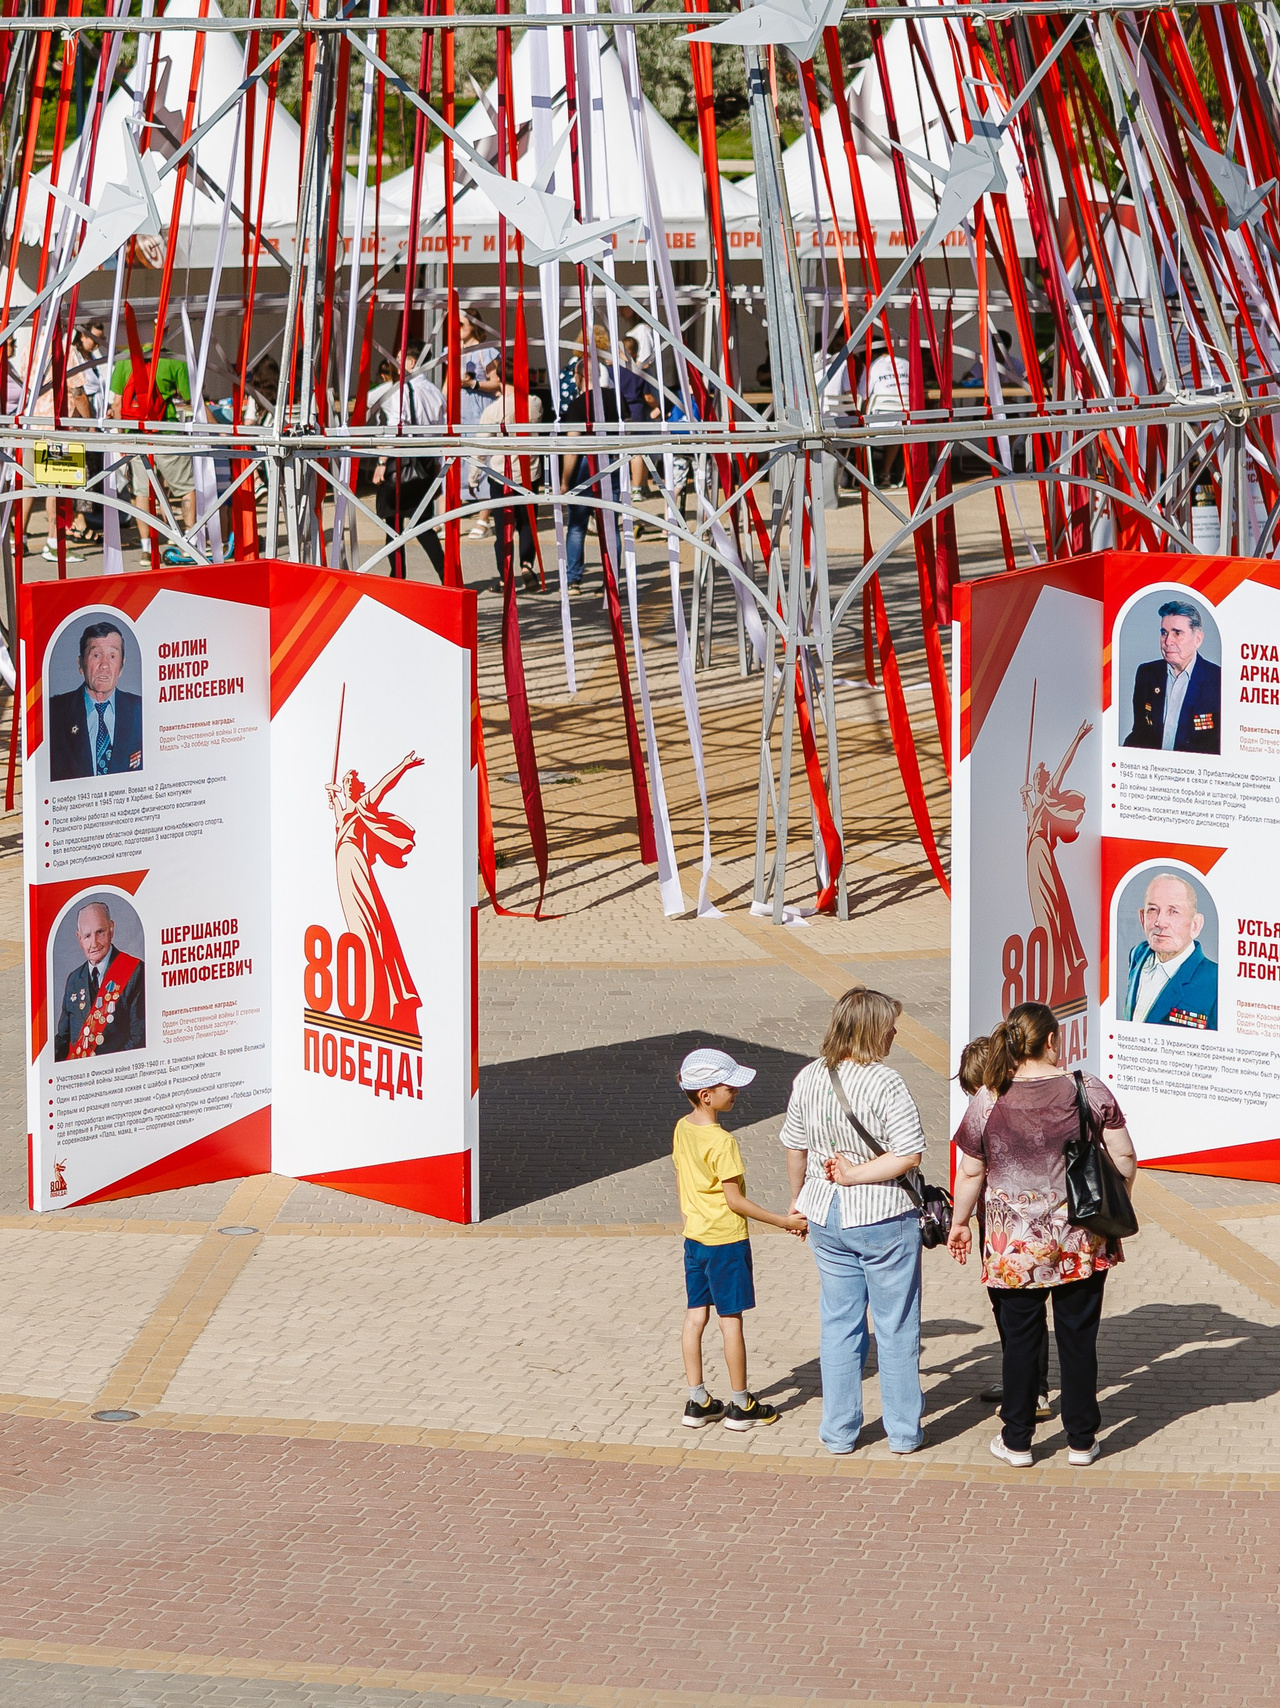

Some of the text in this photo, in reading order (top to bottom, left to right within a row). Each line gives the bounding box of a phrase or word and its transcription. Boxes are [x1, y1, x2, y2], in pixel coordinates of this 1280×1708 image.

[398, 234, 472, 252] «ПОРТ
[158, 638, 207, 660] ФИЛИН
[158, 659, 209, 682] ВИКТОР
[158, 677, 244, 703] АЛЕКСЕЕВИЧ
[160, 918, 239, 945] ШЕРШАКОВ
[161, 939, 241, 967] АЛЕКСАНДР
[161, 958, 253, 988] ТИМОФЕЕВИЧ
[304, 924, 366, 1021] 80
[1002, 926, 1048, 1021] 80
[304, 1027, 422, 1100] ПОБЕДА!
